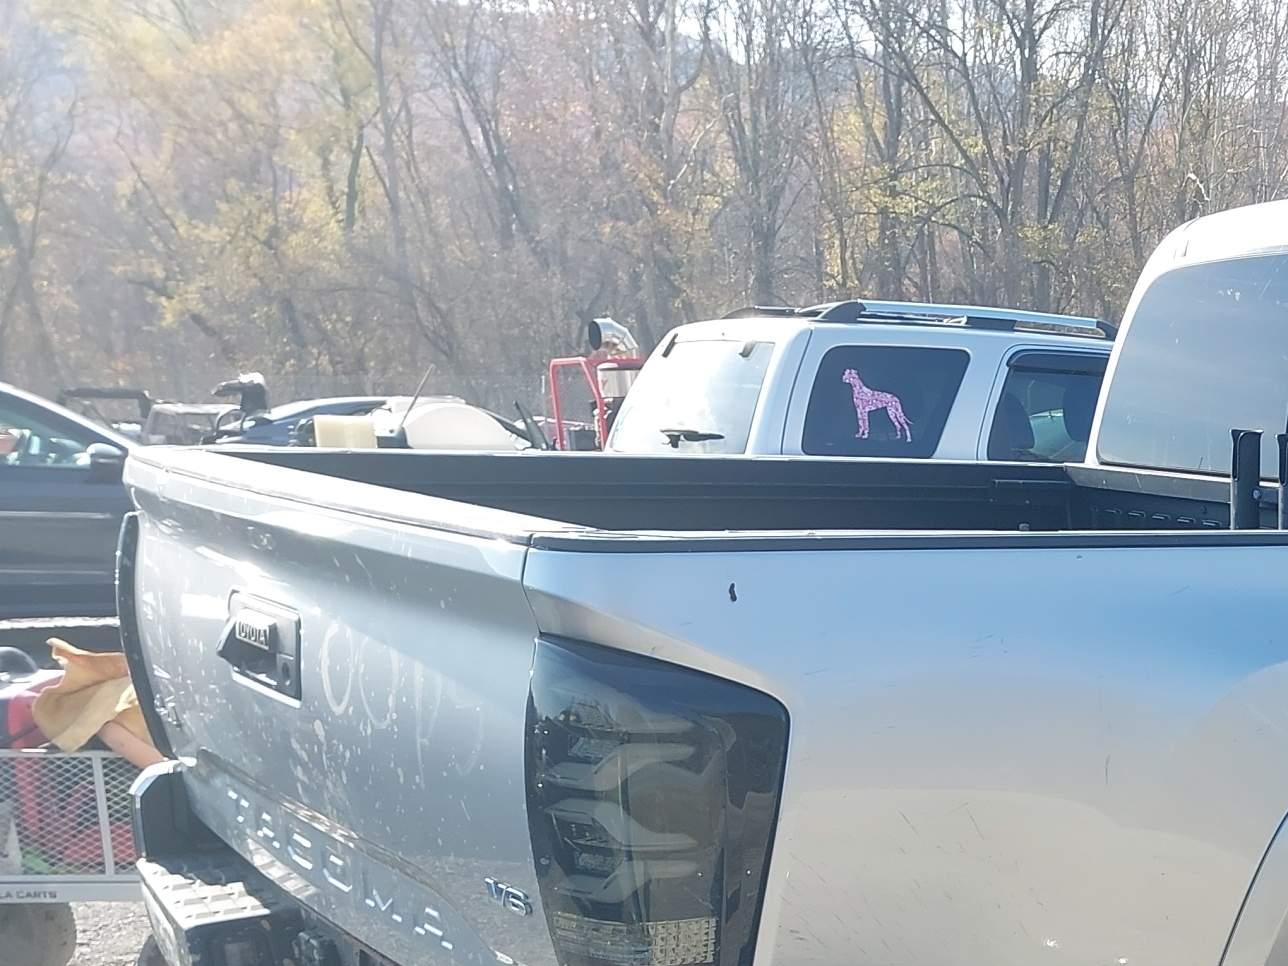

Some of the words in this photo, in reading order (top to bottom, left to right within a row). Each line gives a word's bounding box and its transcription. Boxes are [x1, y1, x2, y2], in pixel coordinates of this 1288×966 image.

[226, 788, 454, 950] TACOMA
[16, 890, 57, 899] CARTS
[484, 876, 533, 917] V6
